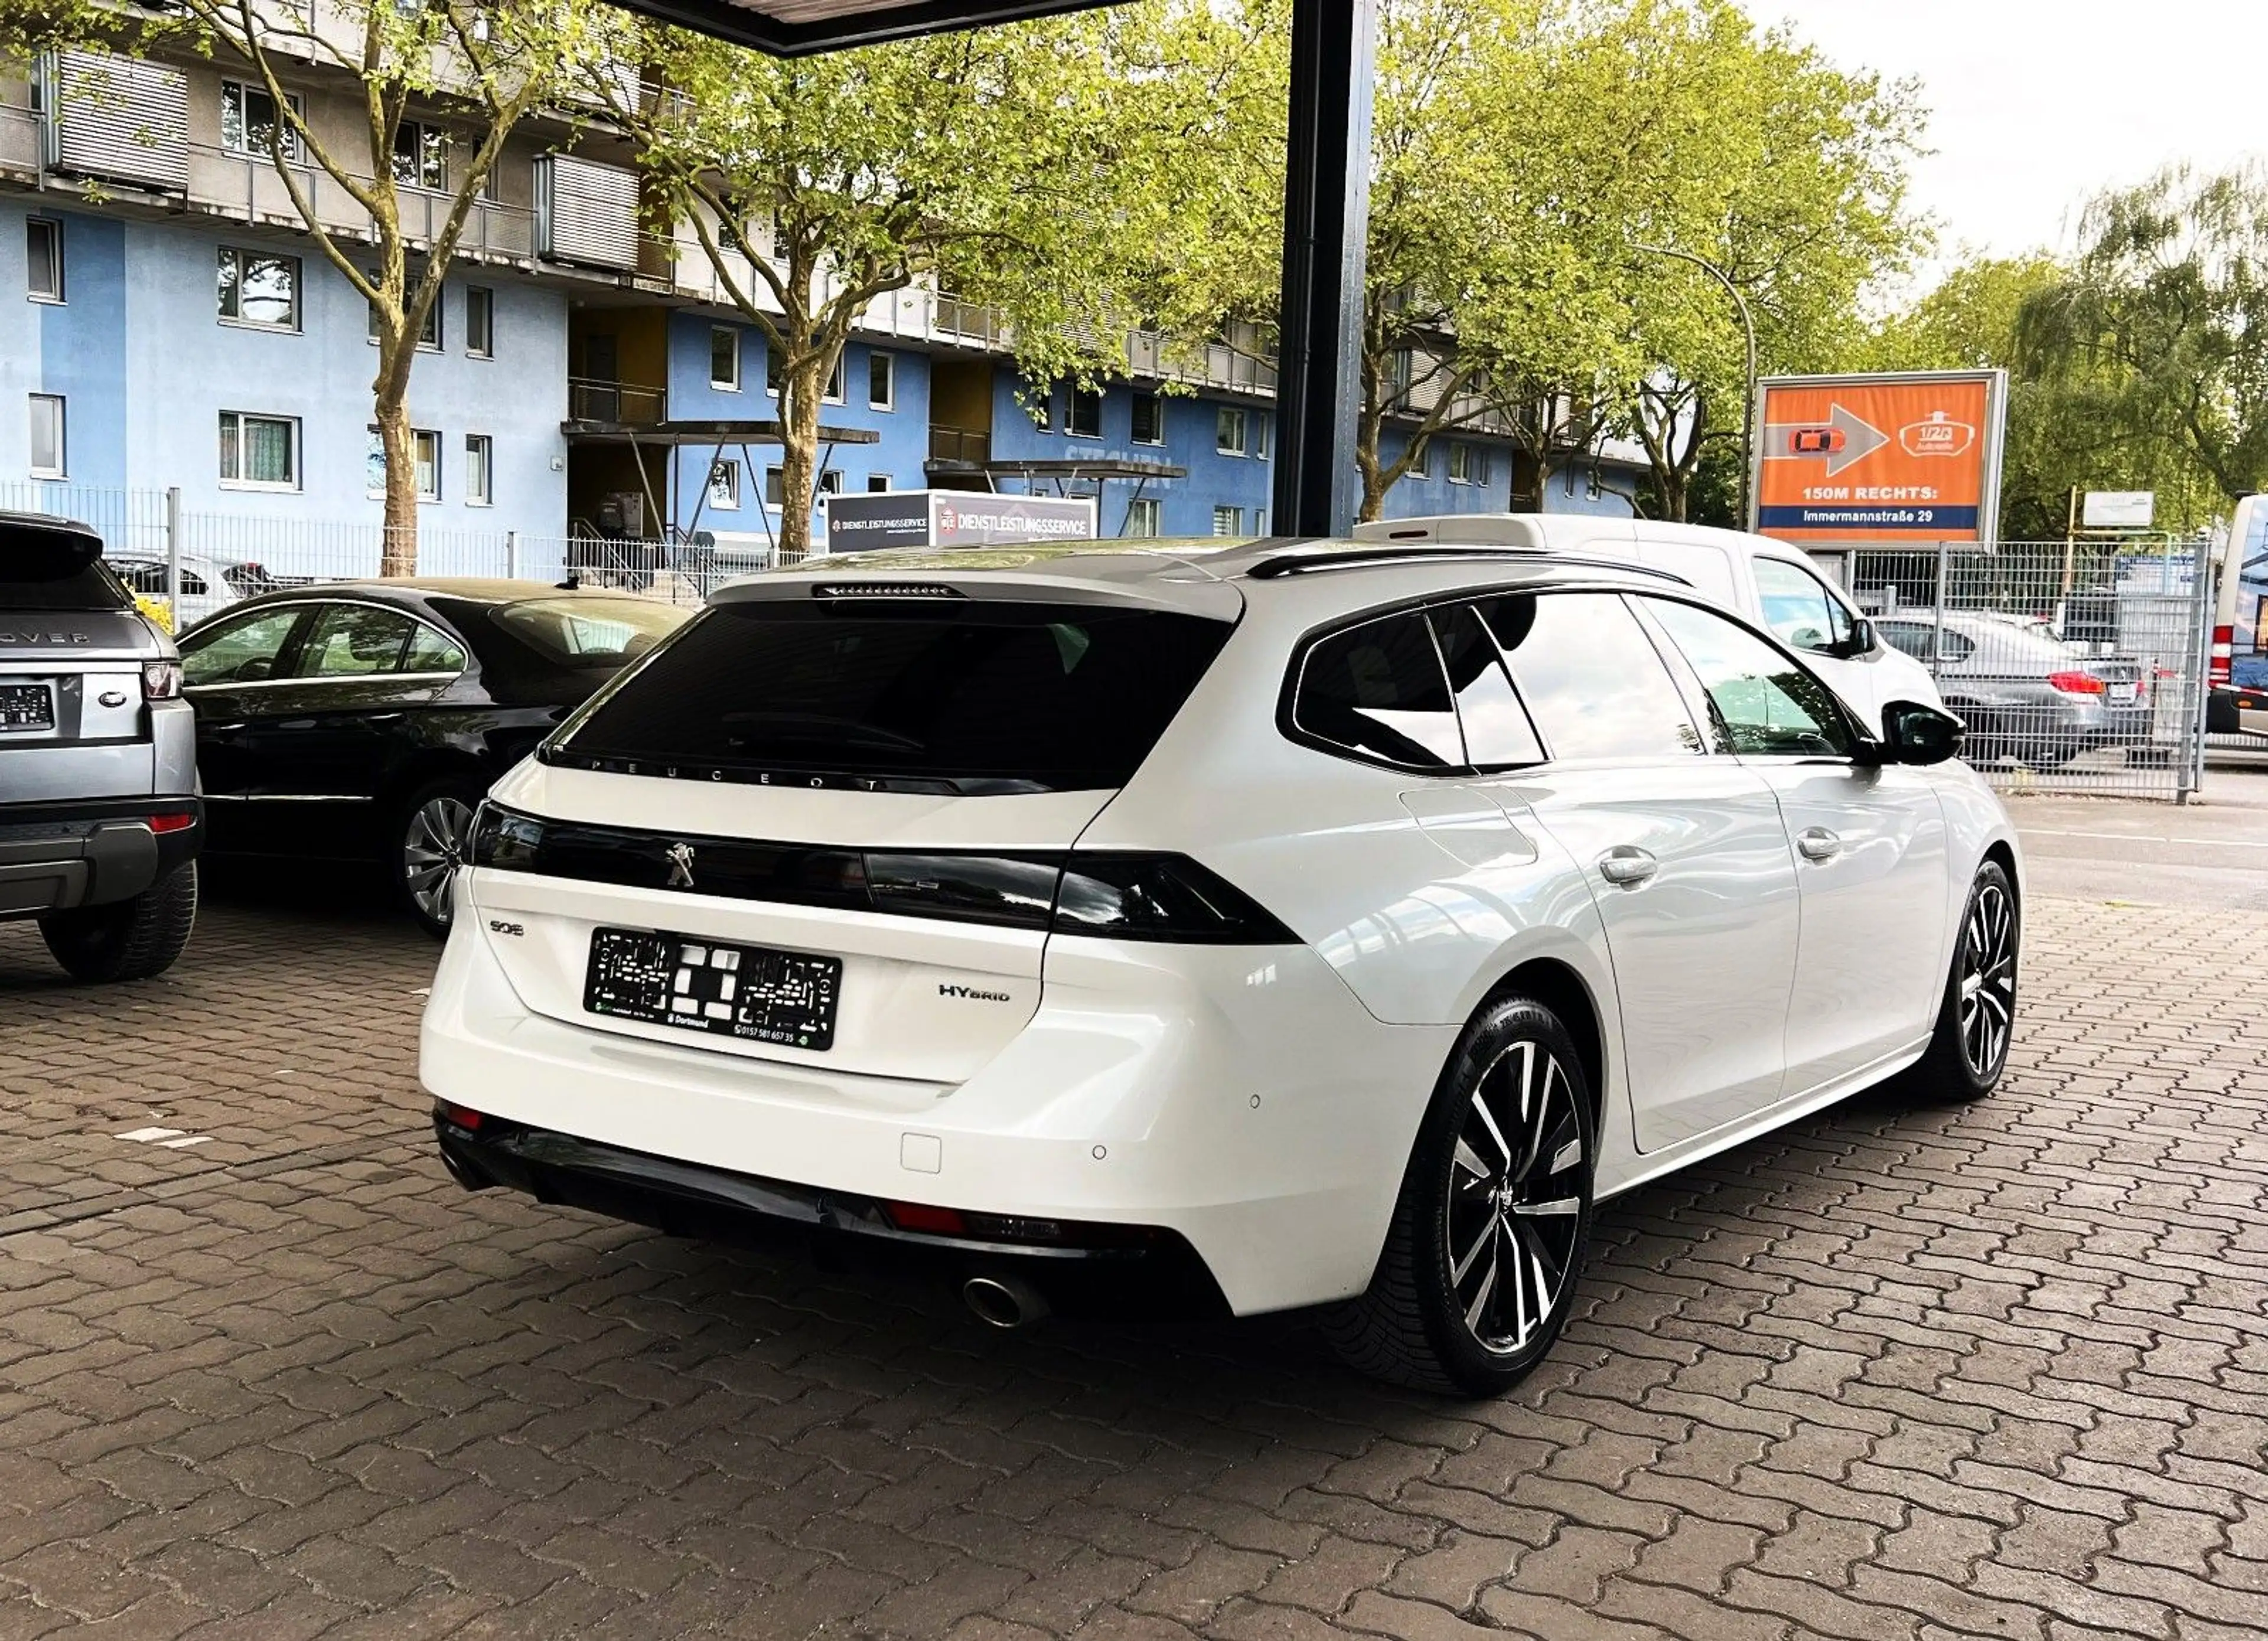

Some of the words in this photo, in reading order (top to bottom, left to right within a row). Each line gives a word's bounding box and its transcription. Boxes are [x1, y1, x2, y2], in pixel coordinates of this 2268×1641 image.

[1919, 426, 1953, 439] 1/2/3
[1803, 486, 1848, 500] 150M
[1855, 487, 1938, 500] RECHTS:
[1803, 510, 1912, 523] Immermannstraße
[1917, 511, 1933, 523] 29
[957, 513, 1087, 536] DIENSTLEISTUNGSSERVICE
[490, 920, 524, 937] 508
[674, 1014, 709, 1029] Dortmund
[741, 1026, 758, 1037] 0157
